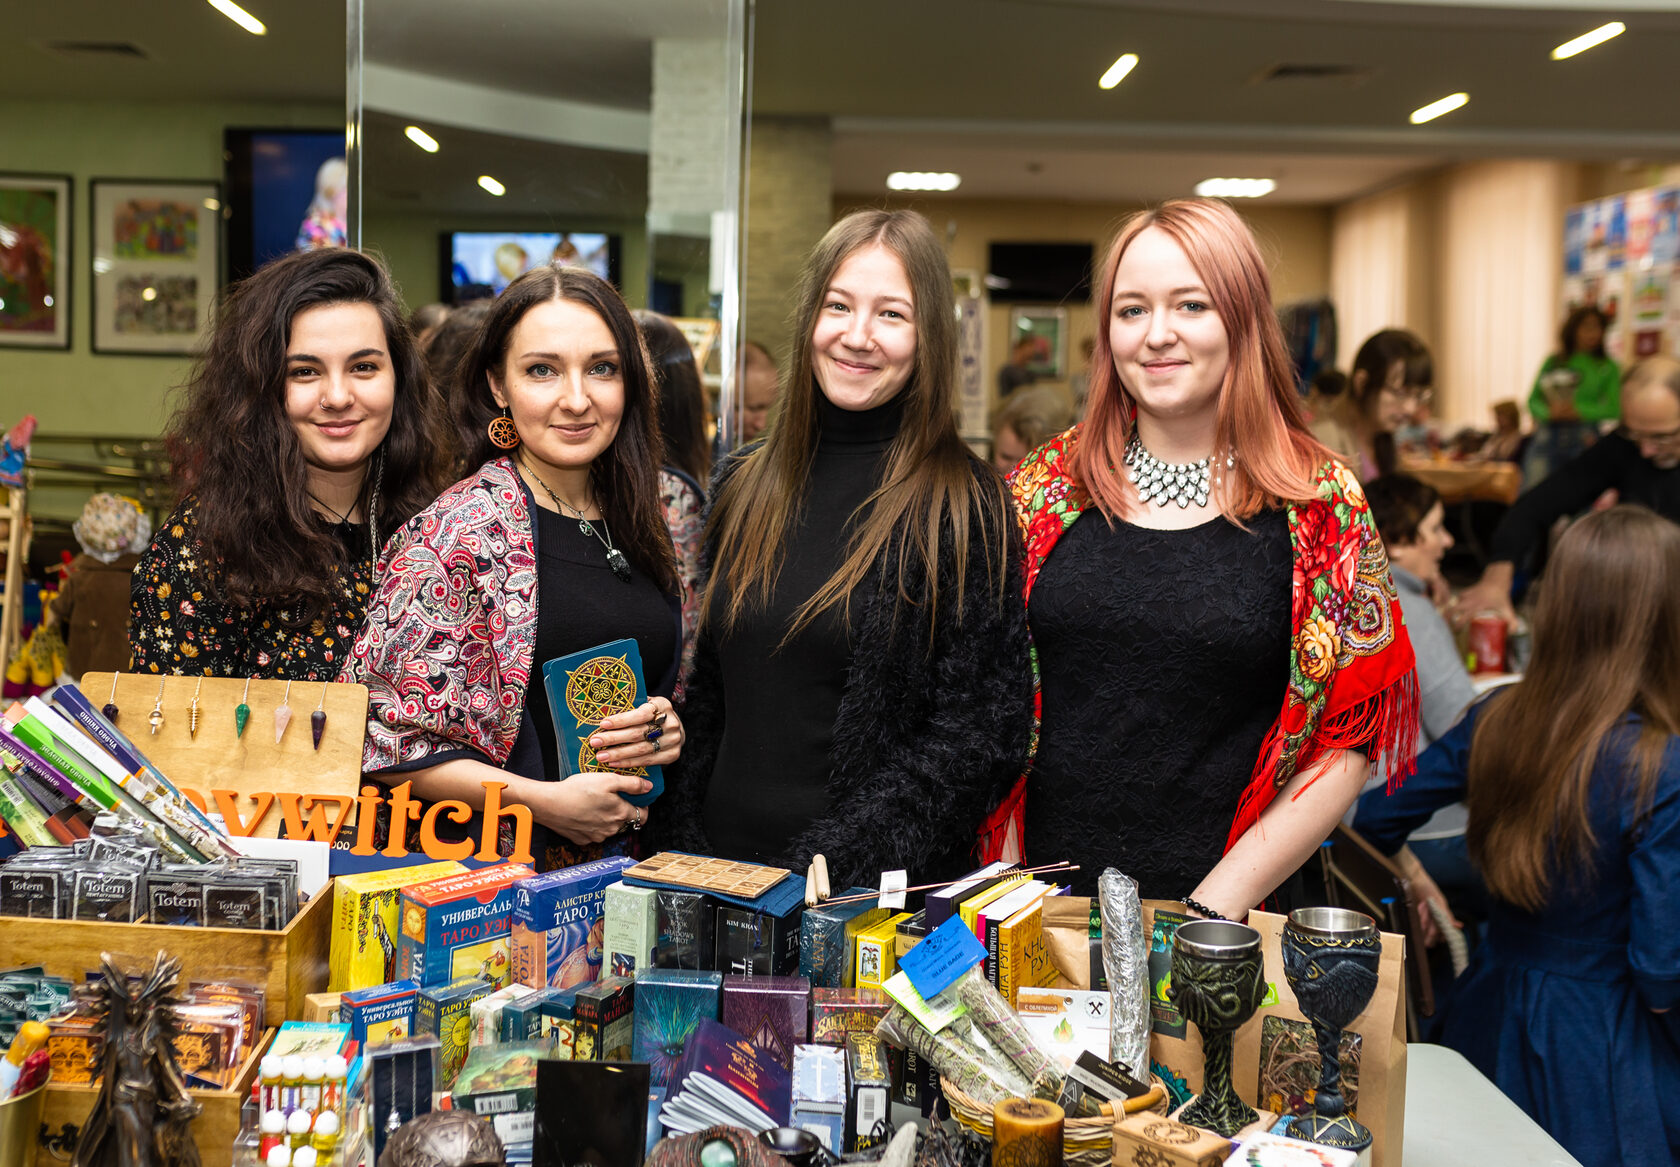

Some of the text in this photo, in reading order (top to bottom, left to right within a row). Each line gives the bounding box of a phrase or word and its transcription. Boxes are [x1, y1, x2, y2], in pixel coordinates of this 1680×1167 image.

[9, 879, 44, 892] Totem
[85, 879, 126, 894] Totem
[154, 892, 202, 908] Totem
[216, 901, 251, 912] Totem
[554, 890, 606, 911] АЛИСТЕР КР
[441, 899, 512, 927] УНИВЕРСАЛЬ
[553, 905, 589, 926] ТАРО
[440, 924, 480, 946] ТАРО
[485, 914, 512, 935] УЭЙ
[726, 919, 739, 927] KIM
[663, 928, 695, 938] SHADOWS
[988, 926, 998, 960] БОЛЬШАЯ
[999, 942, 1009, 969] РУН
[361, 998, 415, 1016] Универсальное
[418, 996, 436, 1010] ТАРО
[440, 1001, 462, 1017] ТАРО
[362, 1011, 386, 1024] ТАРО
